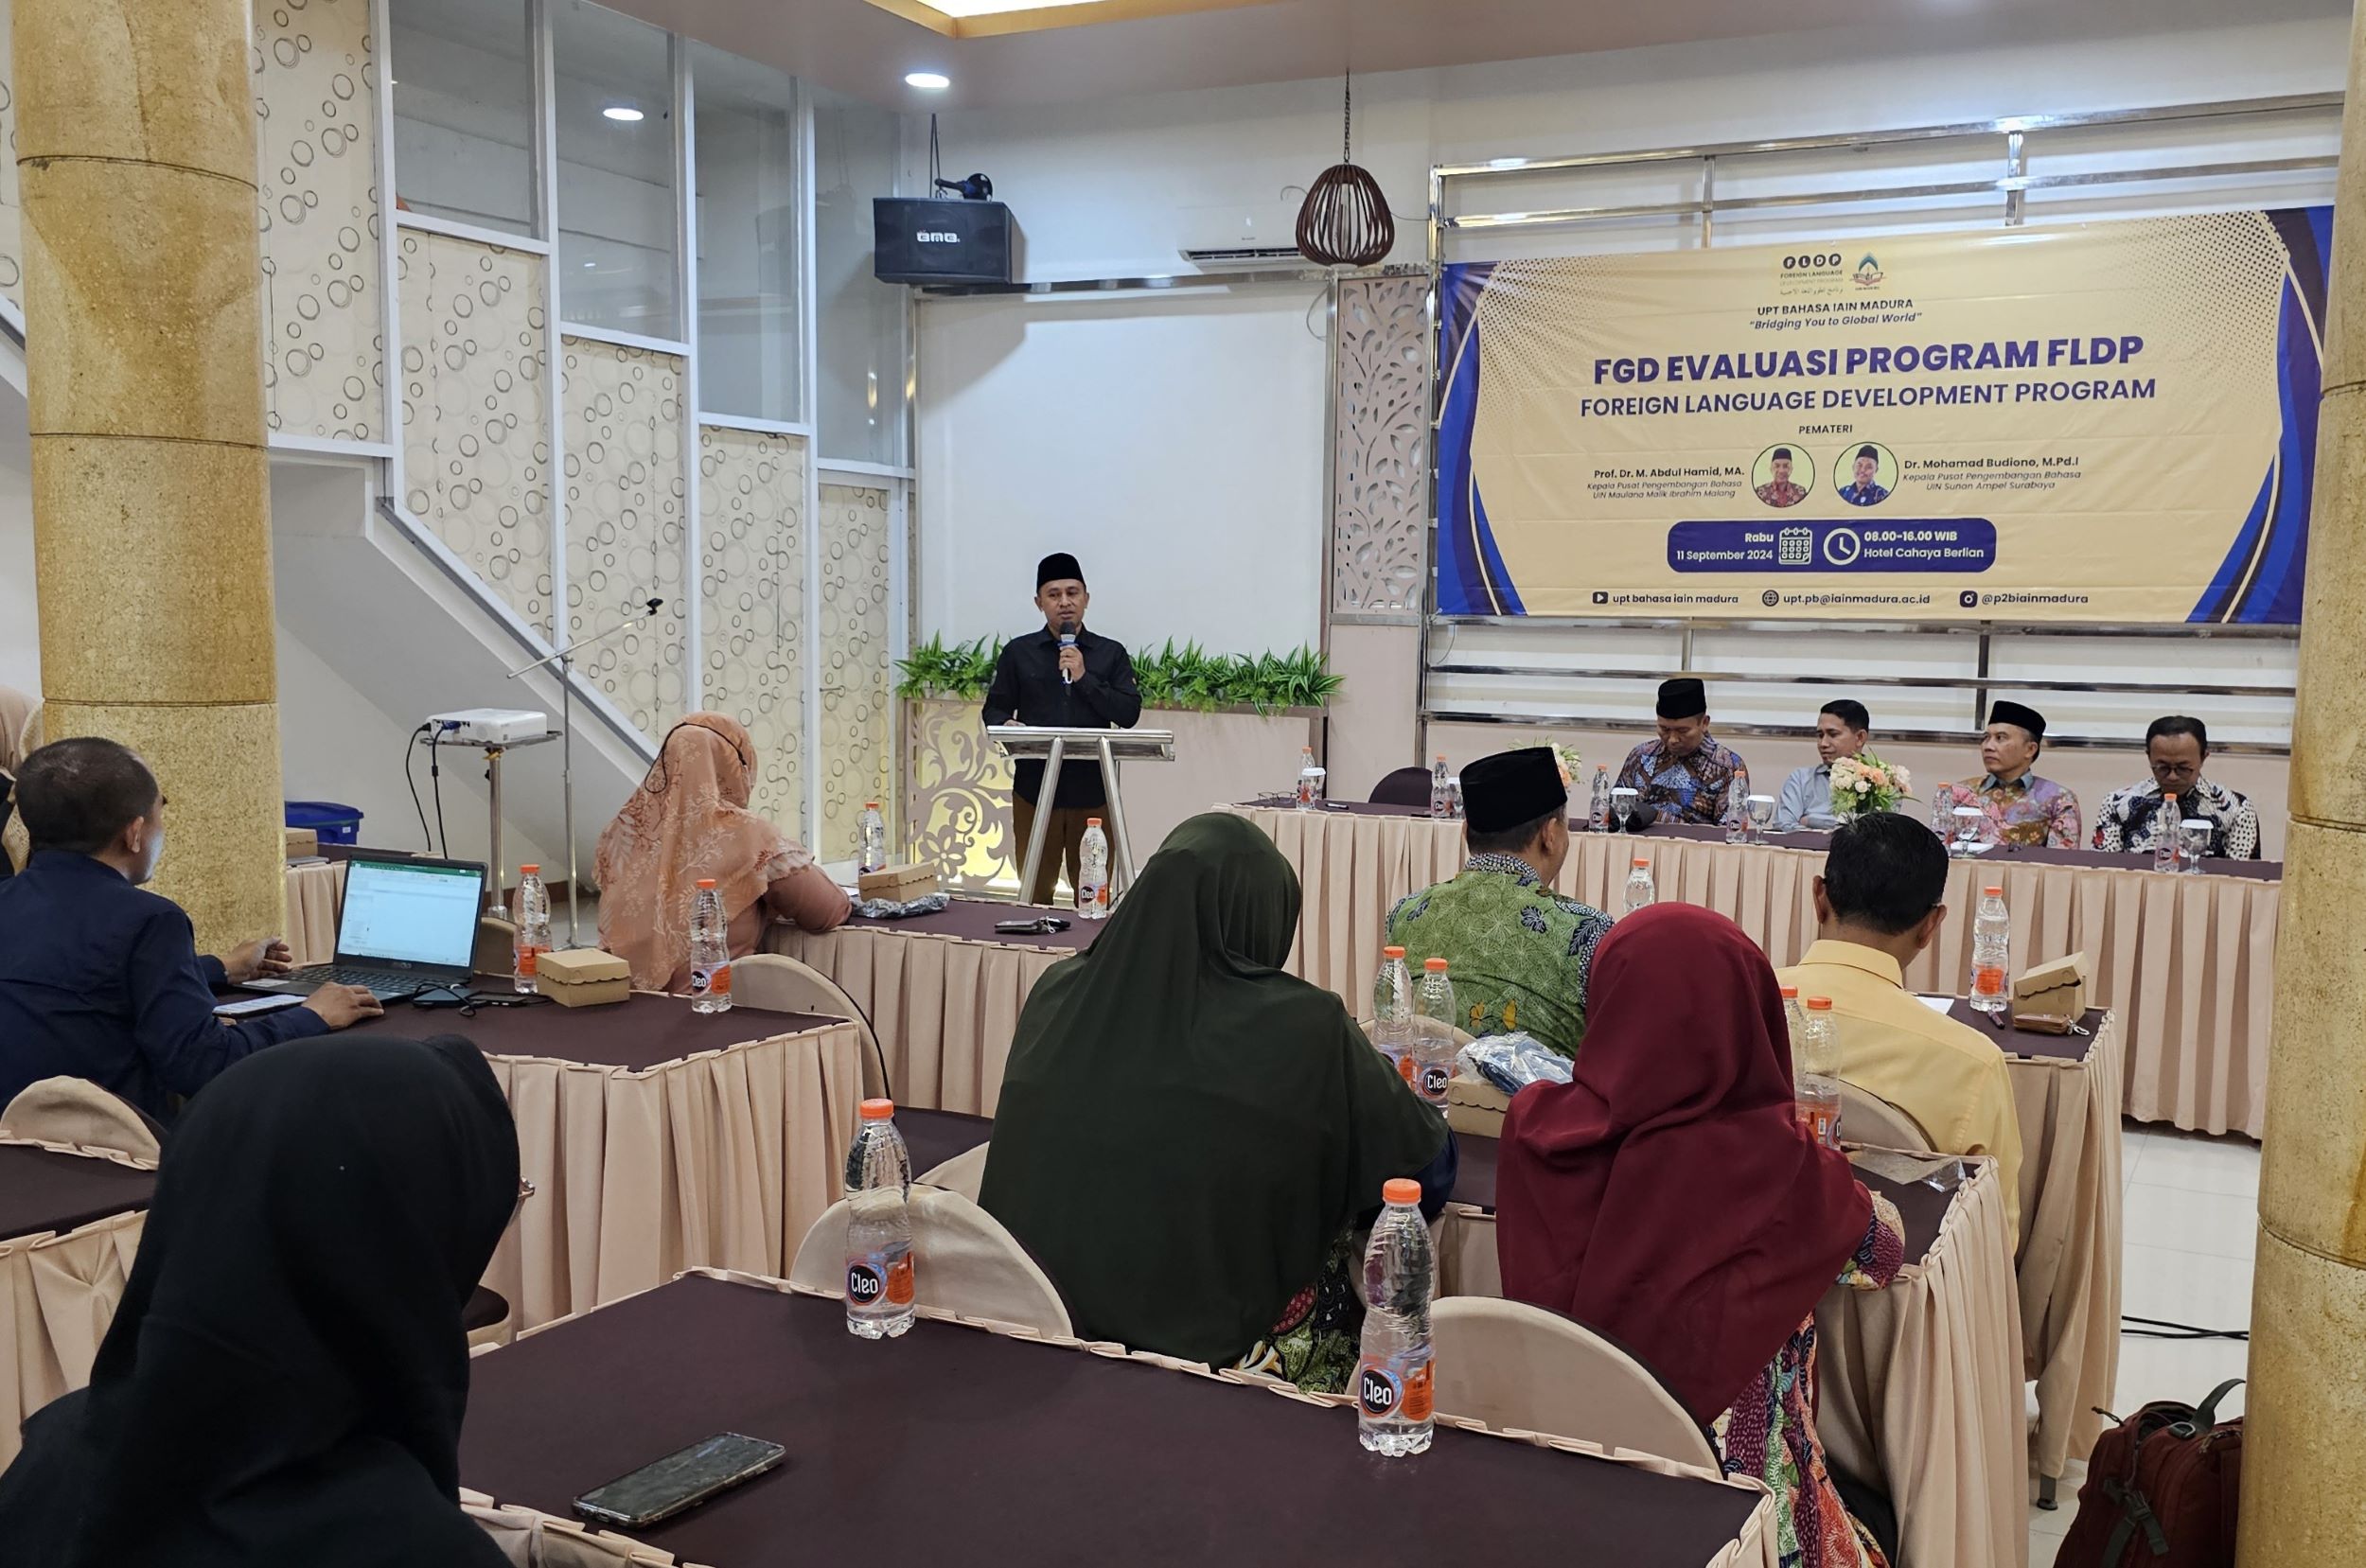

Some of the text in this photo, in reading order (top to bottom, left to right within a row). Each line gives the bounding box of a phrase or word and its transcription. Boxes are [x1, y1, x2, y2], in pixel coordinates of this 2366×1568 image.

[1757, 299, 1914, 316] UPT BAHASA IAIN MADURA
[1806, 318, 1826, 327] You
[1828, 316, 1839, 326] to
[1842, 314, 1879, 325] Global
[1595, 336, 2144, 385] FGD EVALUASI PROGRAM FLDP
[1580, 379, 2156, 416] FOREIGN LANGUAGE DEVELOPMENT PROGRAM
[1798, 424, 1853, 434] PEMATERI
[1904, 460, 1920, 469] Dr.
[1923, 458, 1984, 468] Mohamad
[1986, 457, 2039, 468] Budiono,
[1594, 467, 1744, 479] Prof. Dr. M. Abdul Hamid, MA.
[1902, 470, 2082, 483] Kepala Pusat Pengembangan Bahasa
[1587, 483, 1616, 491] Kepala
[1641, 481, 1707, 491] Pengembangan
[1710, 480, 1742, 488] Bahasa
[1926, 480, 2056, 491] UIN Sunan Ampel Surabaya
[1669, 489, 1702, 498] Ibrahim
[1704, 489, 1736, 499] Malang
[1744, 532, 1774, 543] Rabu
[1863, 531, 1958, 542] 08.00-16.00 WIB
[1676, 550, 1774, 562] 11 September 2024
[1863, 547, 1985, 560] Hotel Cahaya Berlian
[1613, 593, 1739, 605] upt bahasa iain madura
[1783, 592, 1931, 606] upt.pb@iainmadura.ac.id
[1982, 593, 2089, 606] @p2biainmadura
[1427, 1074, 1447, 1088] Cleo
[851, 1272, 879, 1294] Cleo
[1364, 1377, 1392, 1405] Cleo
